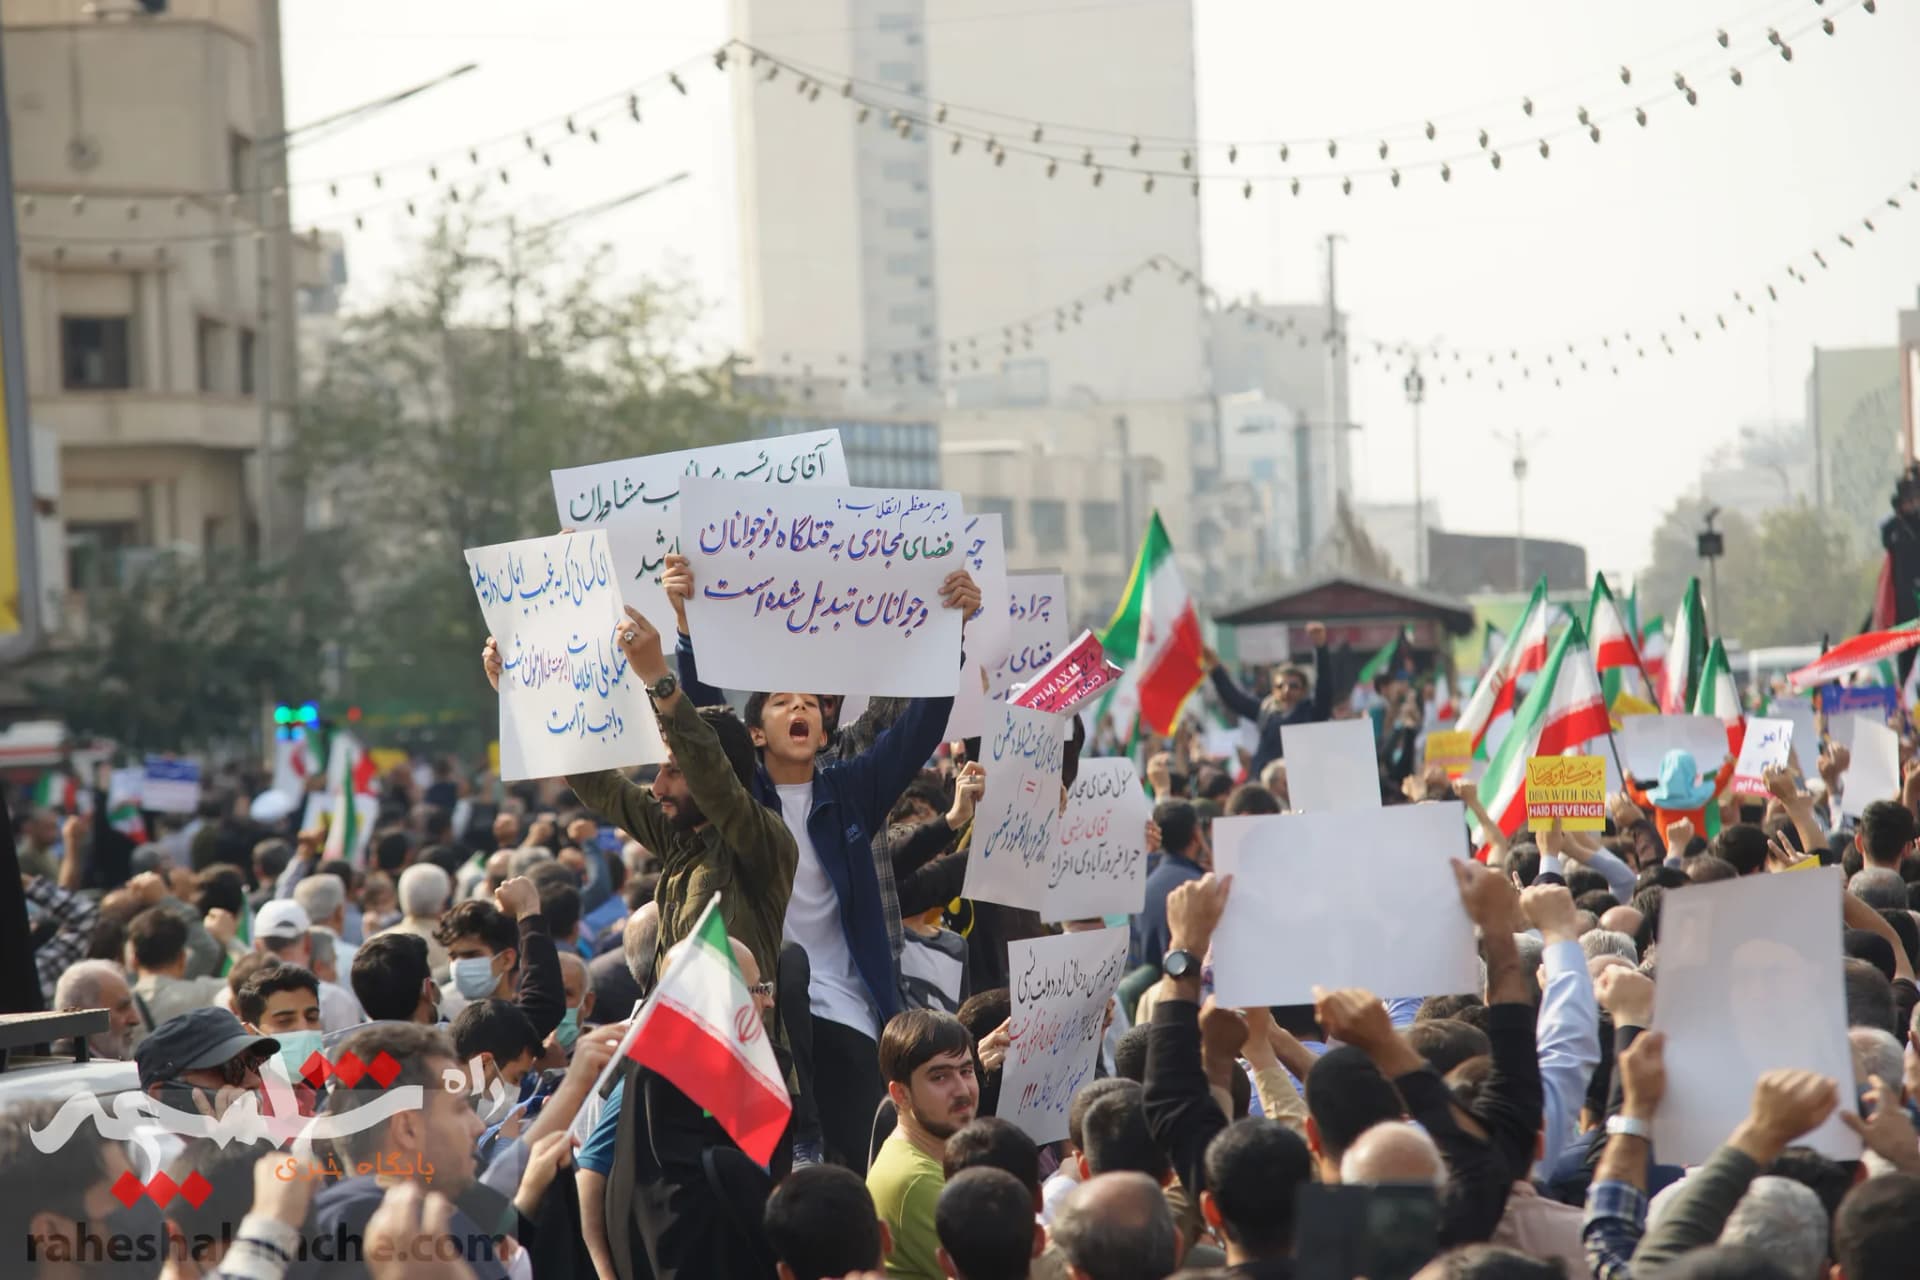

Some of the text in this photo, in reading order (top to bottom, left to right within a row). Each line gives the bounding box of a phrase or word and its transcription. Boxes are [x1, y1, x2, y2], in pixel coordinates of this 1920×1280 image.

[777, 437, 834, 483] آقای
[901, 495, 930, 532] معظم
[923, 502, 949, 524] رهبر
[700, 507, 778, 560] نوجوانان
[777, 515, 834, 552] قتلگاه
[829, 538, 845, 562] به
[848, 528, 904, 569] مجازی
[904, 532, 955, 561] فضای
[786, 580, 858, 634] تبدیل
[1010, 642, 1052, 673] فضای
[1551, 804, 1604, 817] REVENGE
